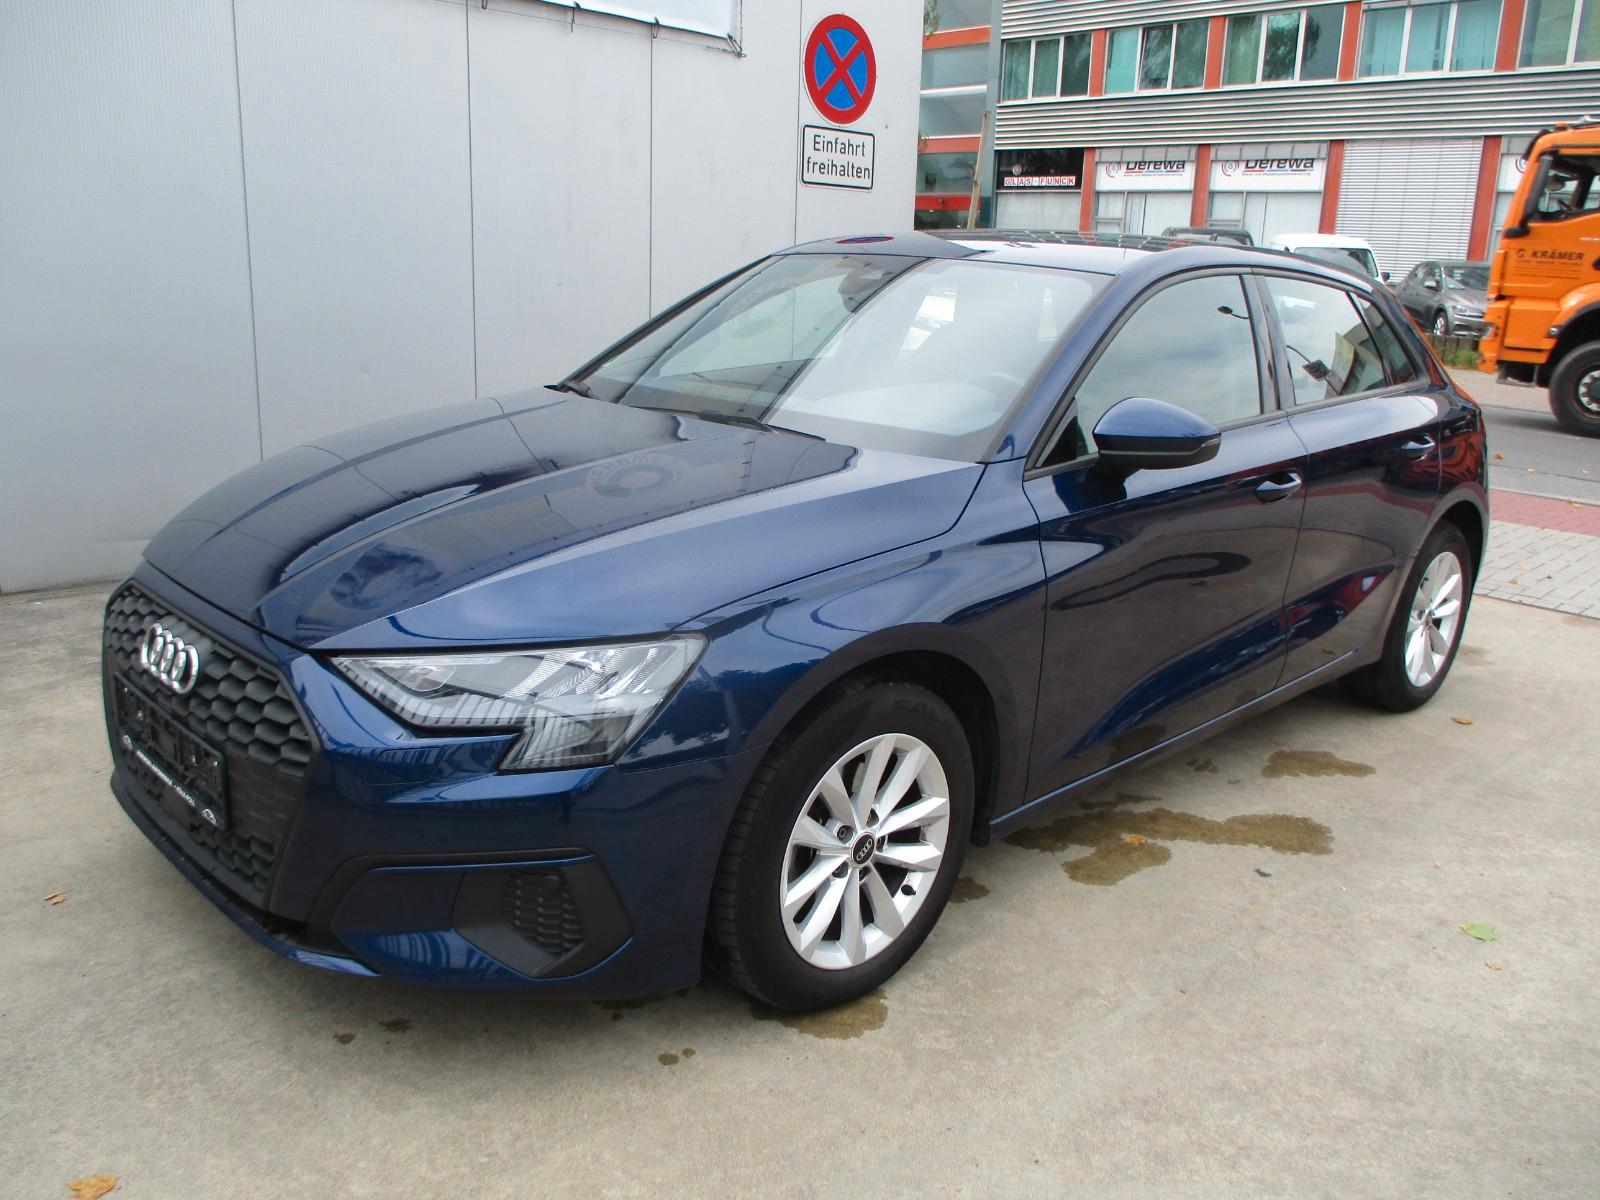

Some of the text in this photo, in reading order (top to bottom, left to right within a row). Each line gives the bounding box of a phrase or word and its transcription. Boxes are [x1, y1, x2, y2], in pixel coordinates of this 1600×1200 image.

[813, 134, 866, 158] Einfahrt
[806, 156, 871, 180] freihalten
[1126, 160, 1185, 170] Derewa
[1244, 158, 1315, 169] Derewa
